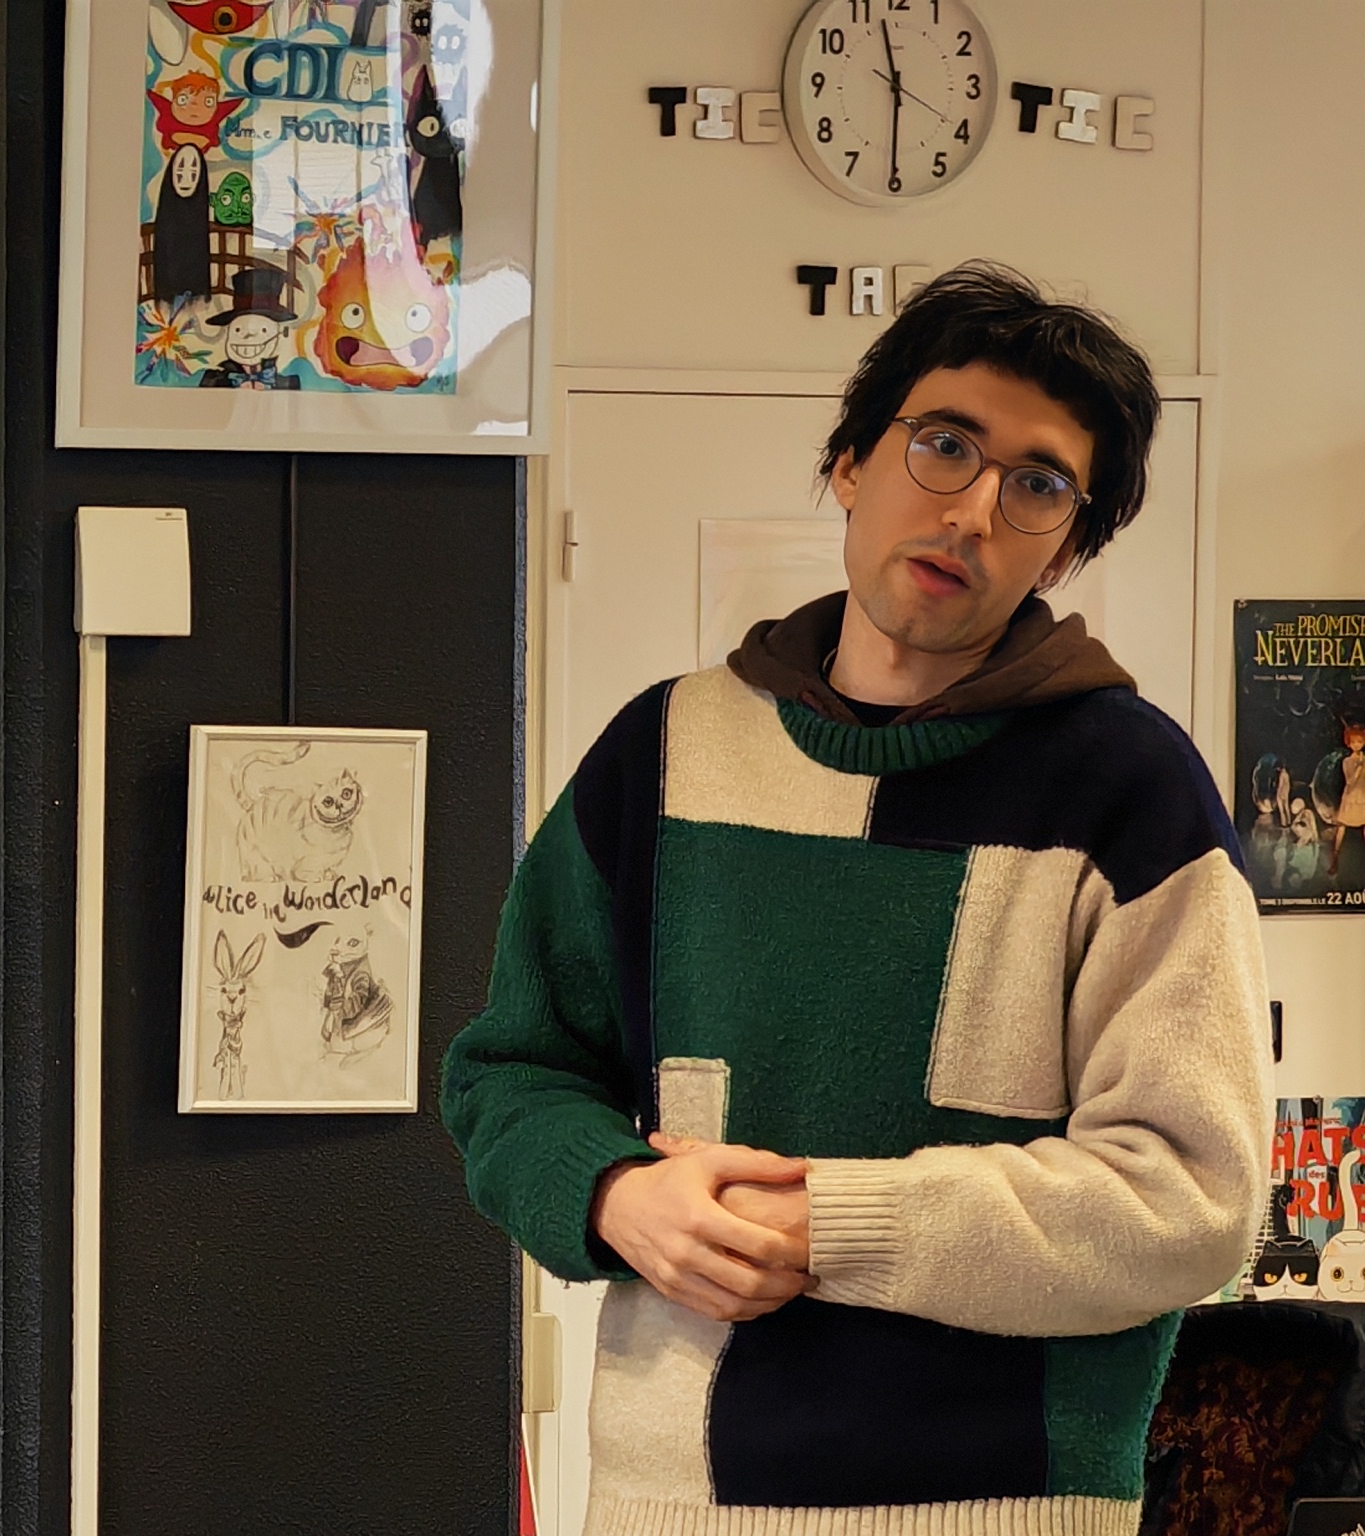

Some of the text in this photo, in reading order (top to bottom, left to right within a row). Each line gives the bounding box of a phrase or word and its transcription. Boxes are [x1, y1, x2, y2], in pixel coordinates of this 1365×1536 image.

[848, 0, 871, 24] 11
[819, 28, 845, 55] 10
[955, 30, 972, 56] 2
[243, 40, 343, 99] CDI
[811, 71, 826, 99] 9
[965, 74, 981, 100] 3
[817, 116, 833, 143] 8
[954, 118, 970, 145] 4
[844, 151, 860, 177] 7
[931, 152, 947, 178] 5
[1273, 622, 1296, 636] THE
[1326, 892, 1342, 905] 22
